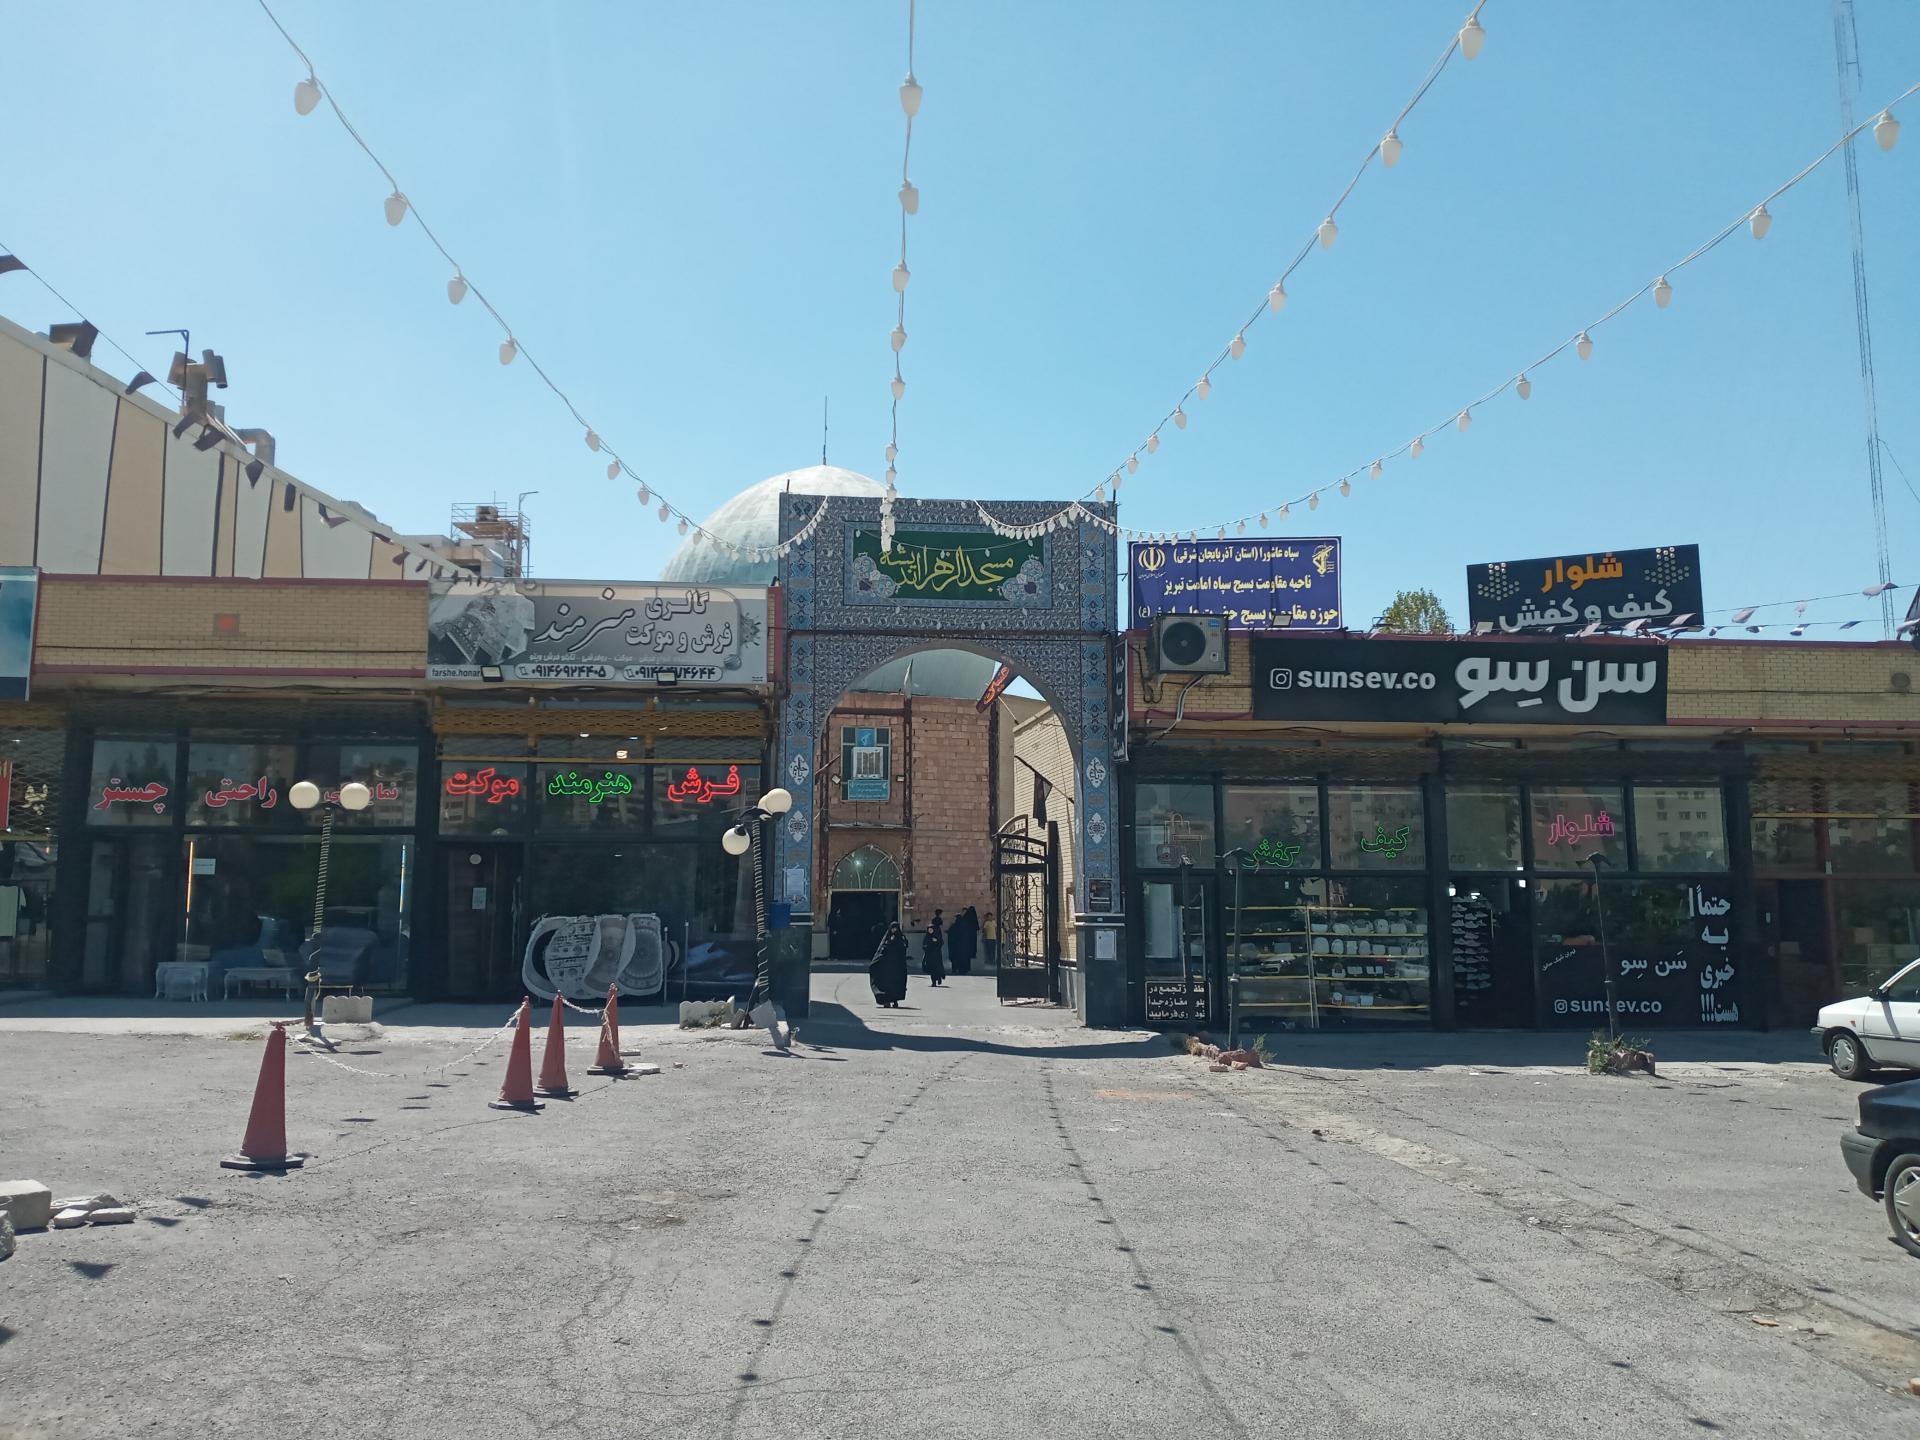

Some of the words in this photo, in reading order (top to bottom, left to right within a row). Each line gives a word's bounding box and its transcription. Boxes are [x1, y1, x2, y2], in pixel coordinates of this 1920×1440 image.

[1199, 545, 1234, 563] آذربایجان
[1260, 546, 1283, 560] عاشورا
[1285, 546, 1300, 562] سپاه
[957, 556, 1014, 592] مسجد
[1164, 576, 1186, 596] تبریز
[1186, 576, 1212, 591] امامت
[1213, 576, 1231, 595] سپاه
[1233, 578, 1255, 593] بسیج
[1256, 574, 1287, 594] مقاومت
[1289, 574, 1312, 593] ناحیه
[1541, 552, 1624, 593] شلوار
[646, 590, 710, 620] گالری
[1241, 608, 1267, 625] بسیج
[1309, 607, 1338, 625] حوزه
[1499, 597, 1580, 633] کفش
[1584, 604, 1602, 626] و
[1608, 590, 1673, 623] کیف
[624, 622, 674, 653] موکت
[676, 632, 689, 654] و
[692, 622, 733, 655] فرش
[1297, 670, 1436, 690] sunsev.co
[1556, 659, 1657, 713] سن
[93, 778, 167, 814] چستر
[205, 775, 277, 809] راحتی
[446, 767, 519, 803] موکت
[548, 772, 632, 803] هنرمند
[667, 764, 740, 802] فرش
[1361, 826, 1409, 859] کیف
[1548, 810, 1616, 845] شلوار
[1241, 839, 1300, 869] کفش
[1701, 925, 1729, 951] یه
[1700, 957, 1735, 989] خبری
